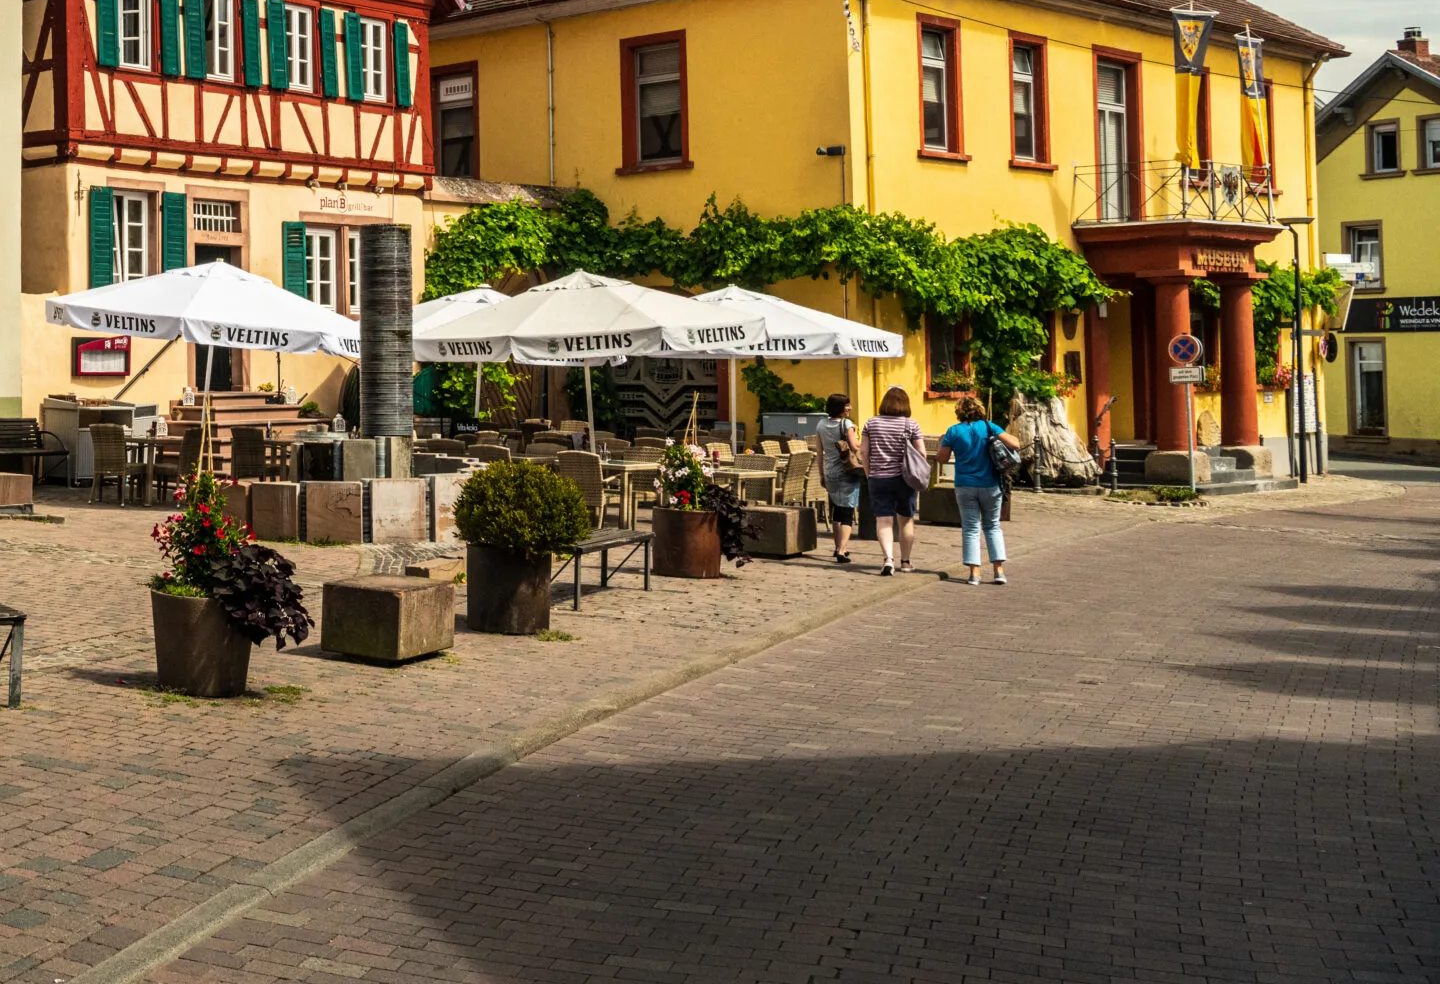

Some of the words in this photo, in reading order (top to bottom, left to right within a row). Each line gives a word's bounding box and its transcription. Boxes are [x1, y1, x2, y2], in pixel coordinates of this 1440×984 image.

[1196, 248, 1250, 267] MUSEUM
[104, 313, 156, 333] VELTINS
[227, 327, 289, 347] VELTINS
[563, 333, 633, 352] VELTINS
[697, 325, 745, 344] VELTINS
[447, 341, 493, 355] VELTINS
[856, 339, 889, 352] VELTINS
